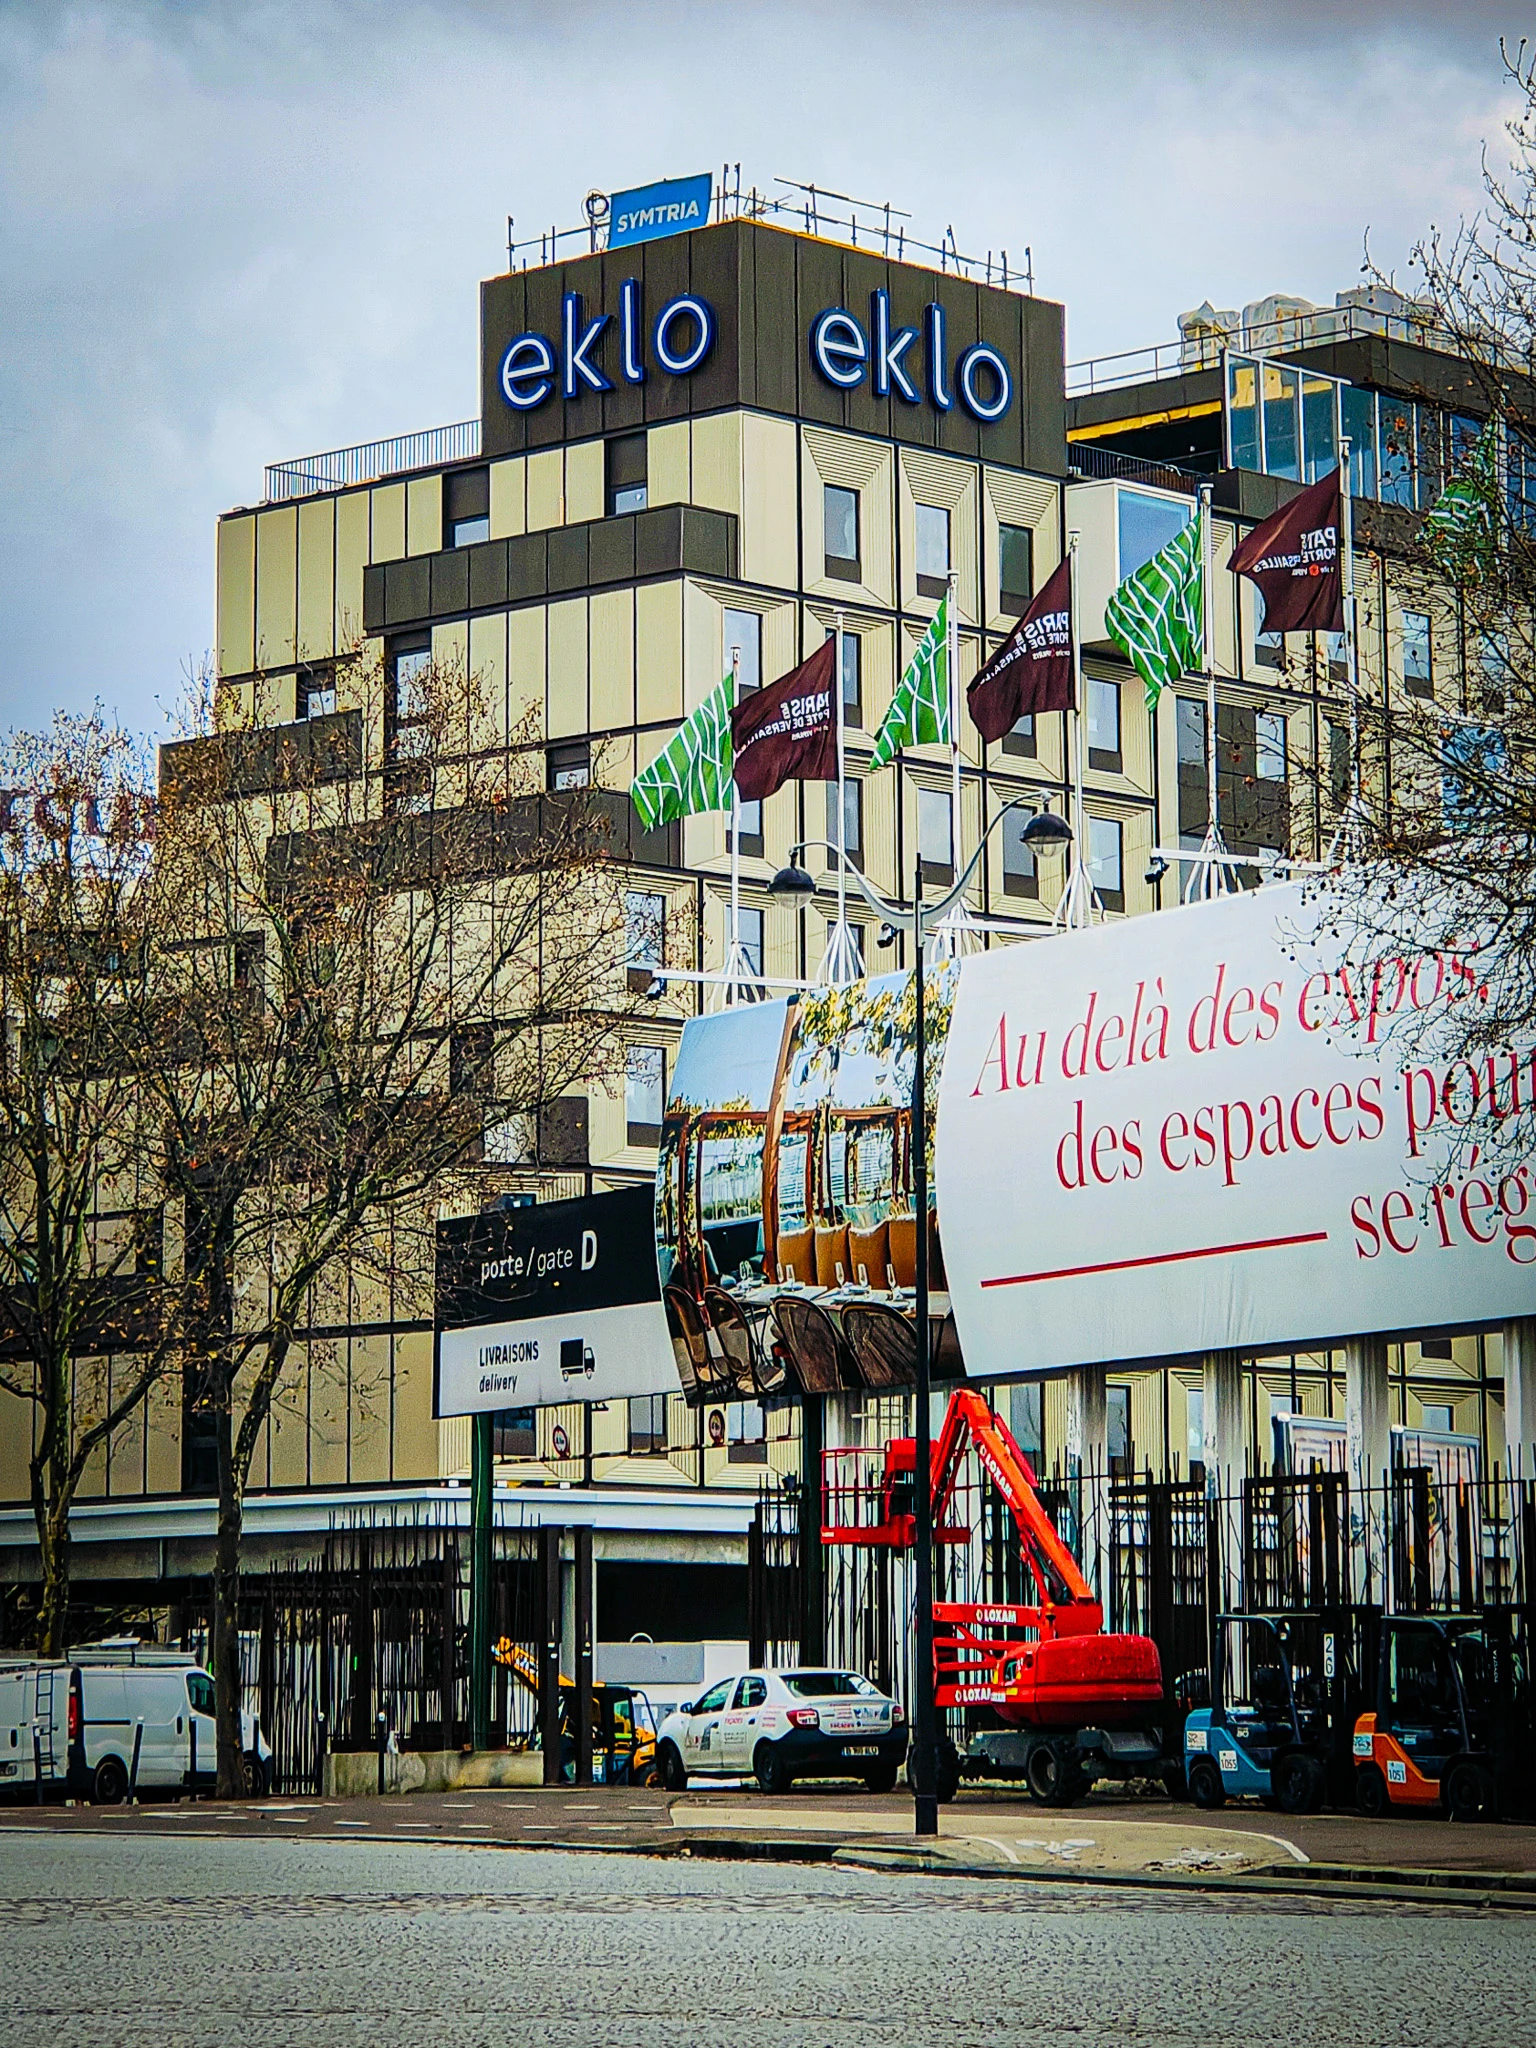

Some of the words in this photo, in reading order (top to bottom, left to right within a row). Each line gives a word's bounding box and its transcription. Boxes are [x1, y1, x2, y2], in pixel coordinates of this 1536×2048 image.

[617, 200, 700, 233] SYMTRIA
[499, 277, 717, 411] eklo
[809, 287, 1015, 422] eklo
[969, 1011, 1047, 1097] Au
[1061, 976, 1170, 1079] delà
[1187, 963, 1284, 1053] des
[1057, 1100, 1142, 1189] des
[1160, 1076, 1384, 1187] espaces
[1351, 1191, 1418, 1259] se
[581, 1230, 598, 1271] D
[479, 1340, 539, 1367] LIVRAISONS
[479, 1373, 518, 1393] delivery
[985, 1453, 1013, 1500] LOXAM
[984, 1608, 1017, 1624] LOXAM
[962, 1687, 991, 1702] LOXA
